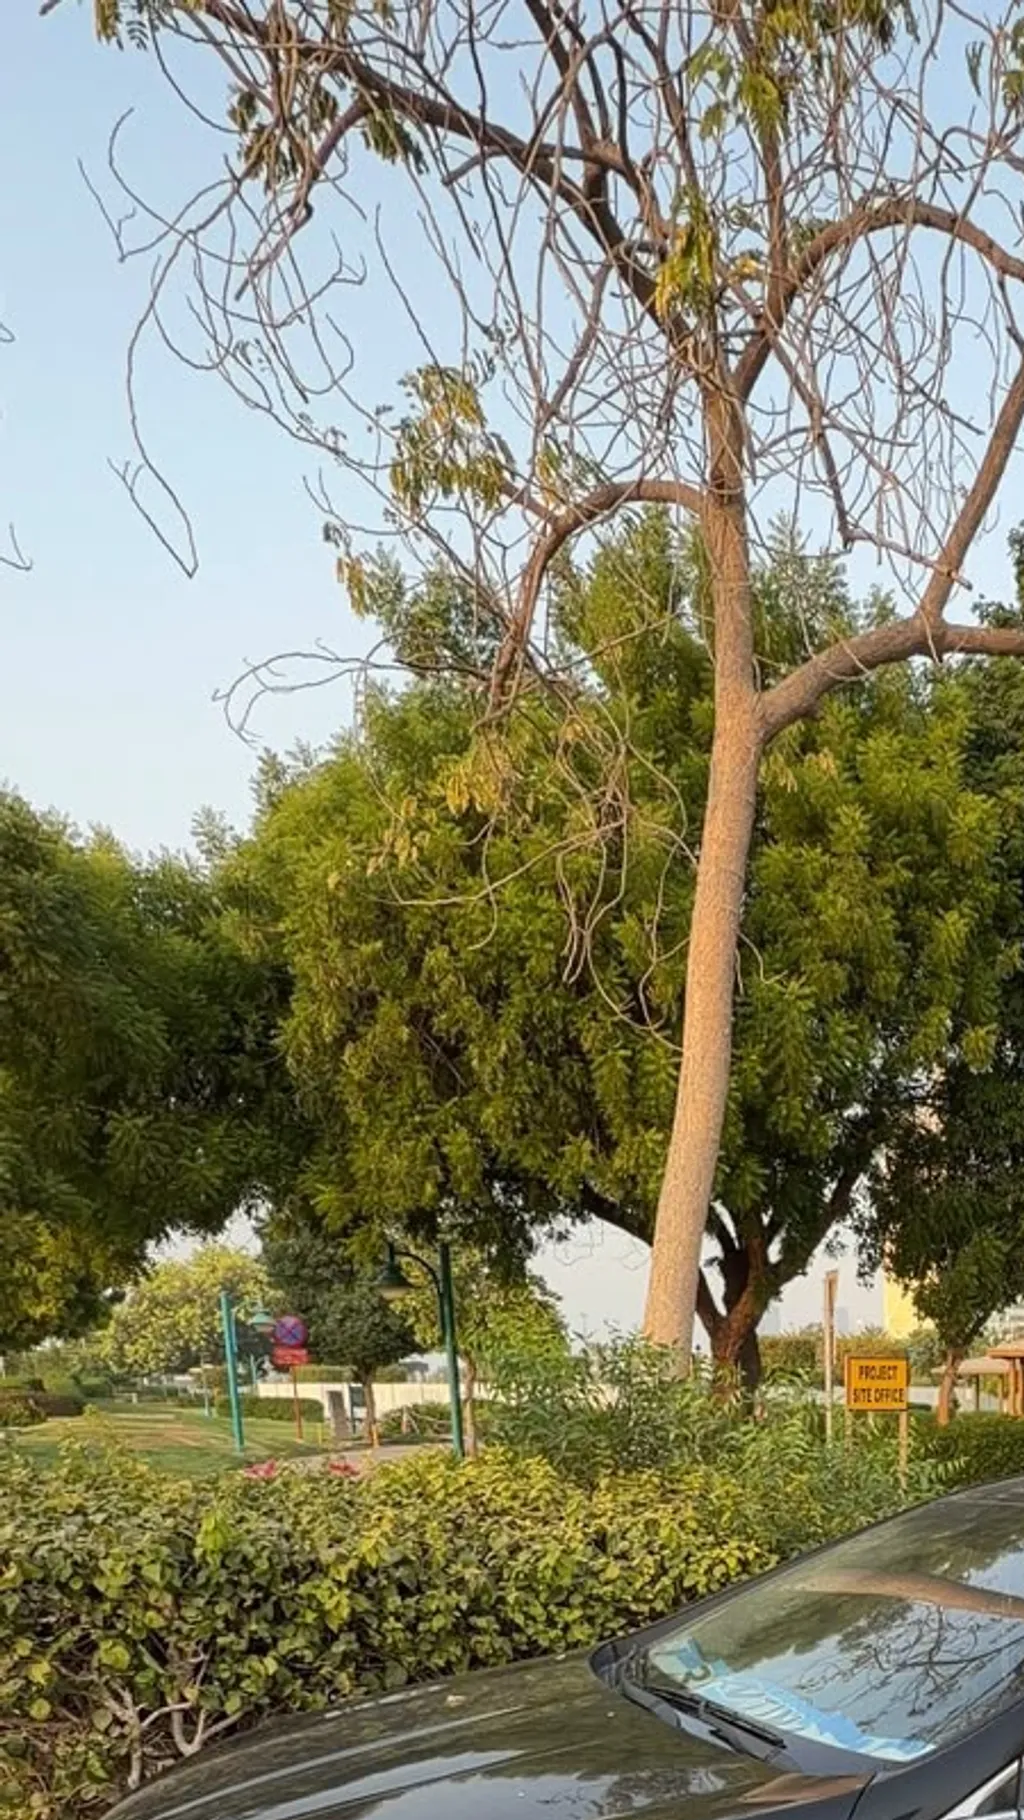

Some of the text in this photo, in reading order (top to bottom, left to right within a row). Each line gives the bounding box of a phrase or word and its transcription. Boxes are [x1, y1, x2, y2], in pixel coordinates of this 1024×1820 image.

[858, 1365, 898, 1380] PROJECT
[853, 1388, 905, 1403] SITE OFFICE
